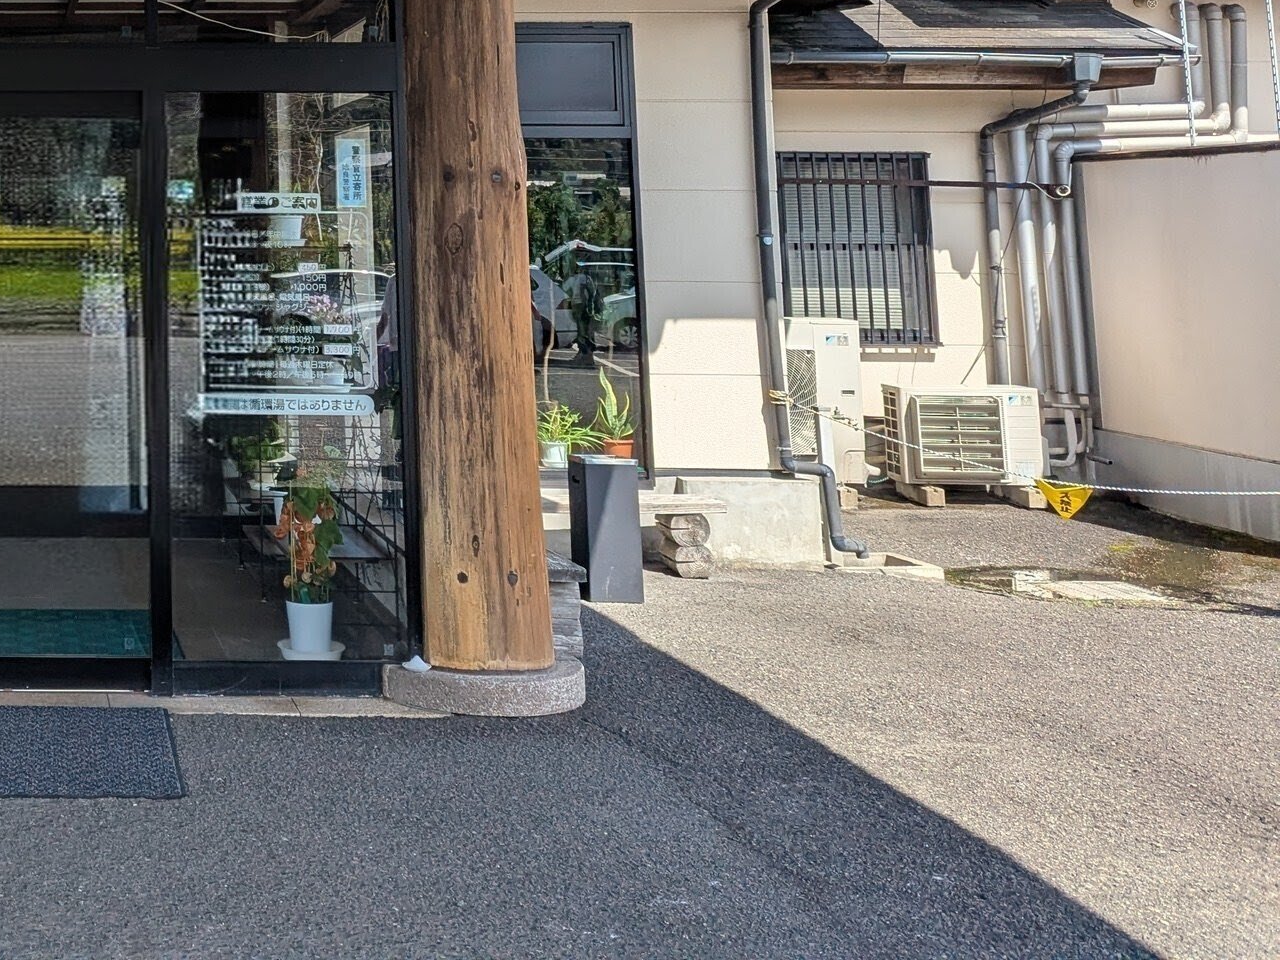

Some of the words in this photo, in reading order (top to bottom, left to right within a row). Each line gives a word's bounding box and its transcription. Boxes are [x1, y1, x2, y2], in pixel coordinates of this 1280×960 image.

[240, 195, 319, 210] 営業のご案内
